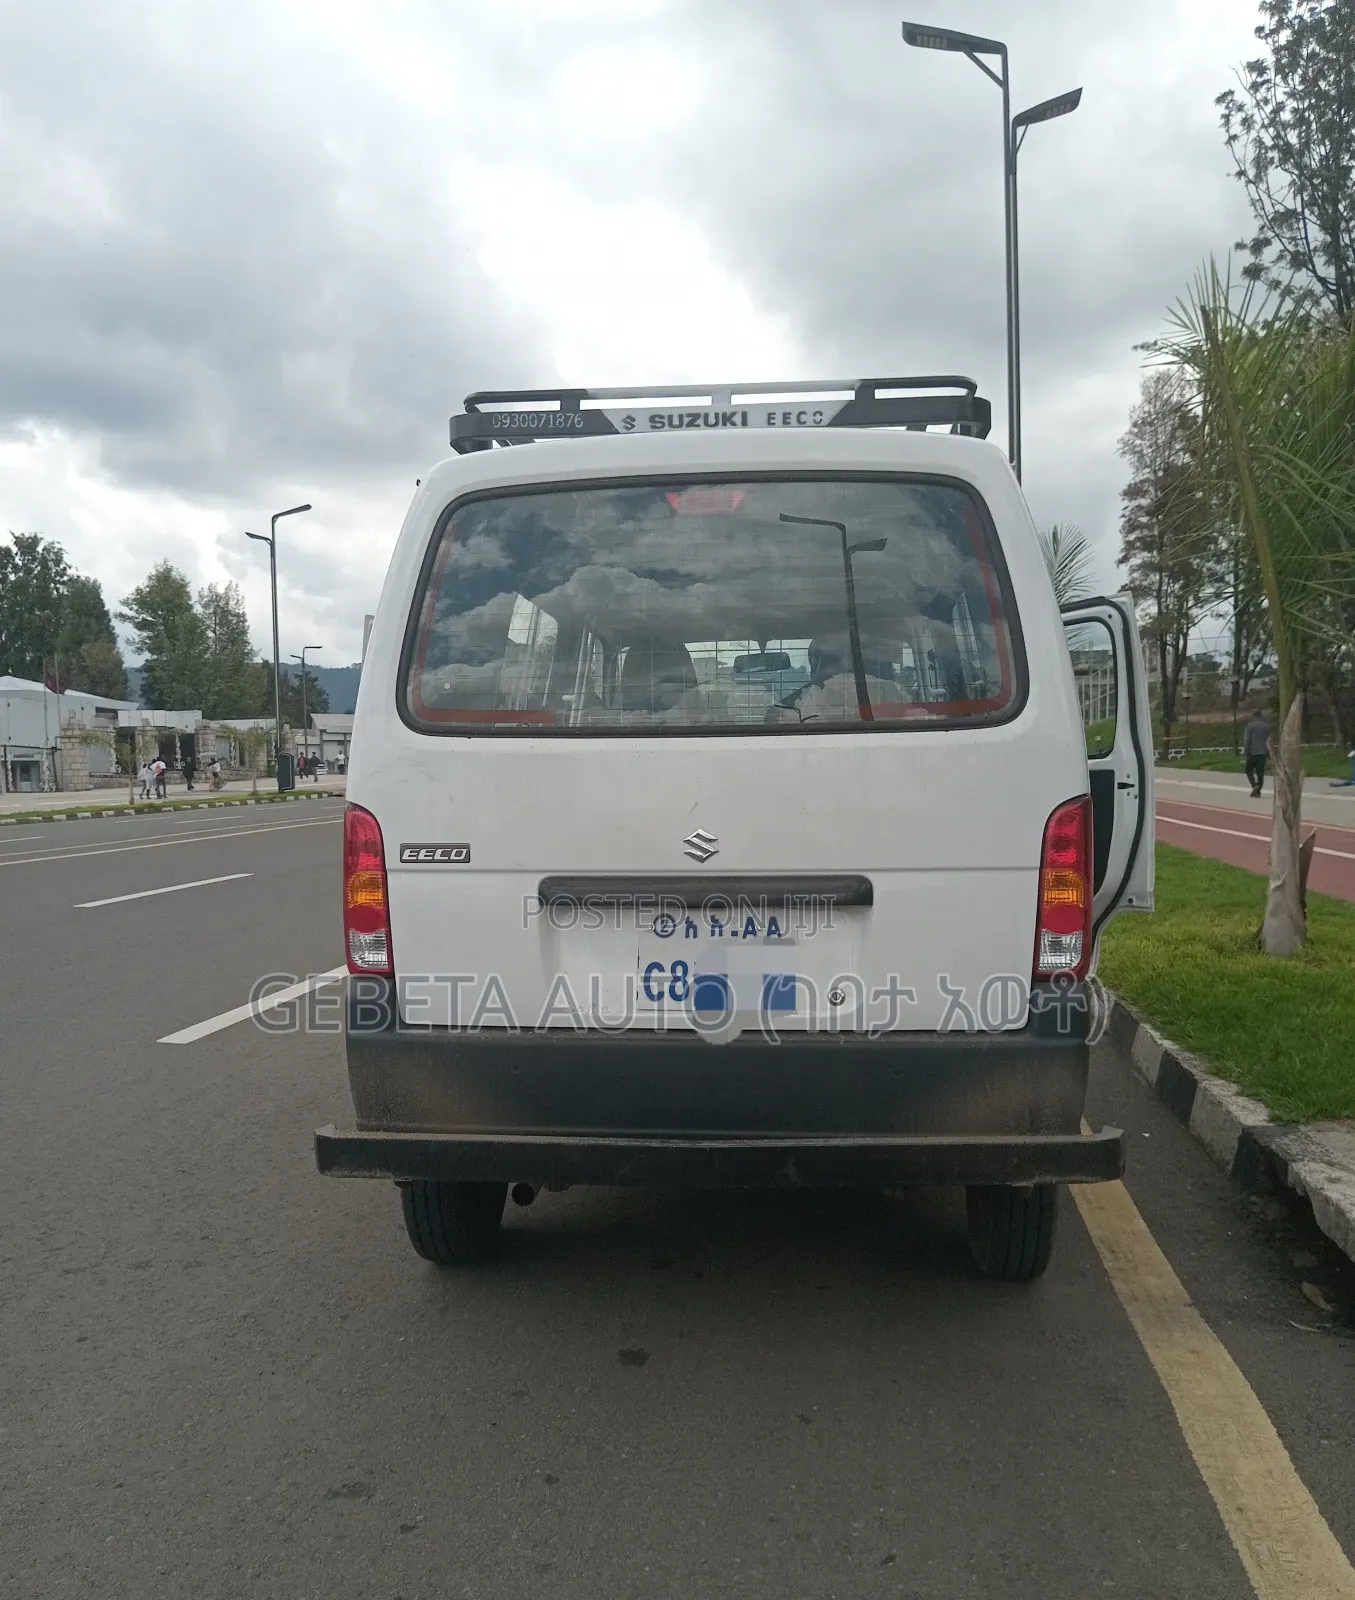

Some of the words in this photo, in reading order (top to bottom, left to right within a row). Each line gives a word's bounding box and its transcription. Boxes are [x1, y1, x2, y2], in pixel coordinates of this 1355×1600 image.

[492, 412, 584, 429] 0930071876
[648, 411, 748, 430] SUZUKI
[767, 410, 822, 426] EECO
[402, 848, 468, 860] EECO
